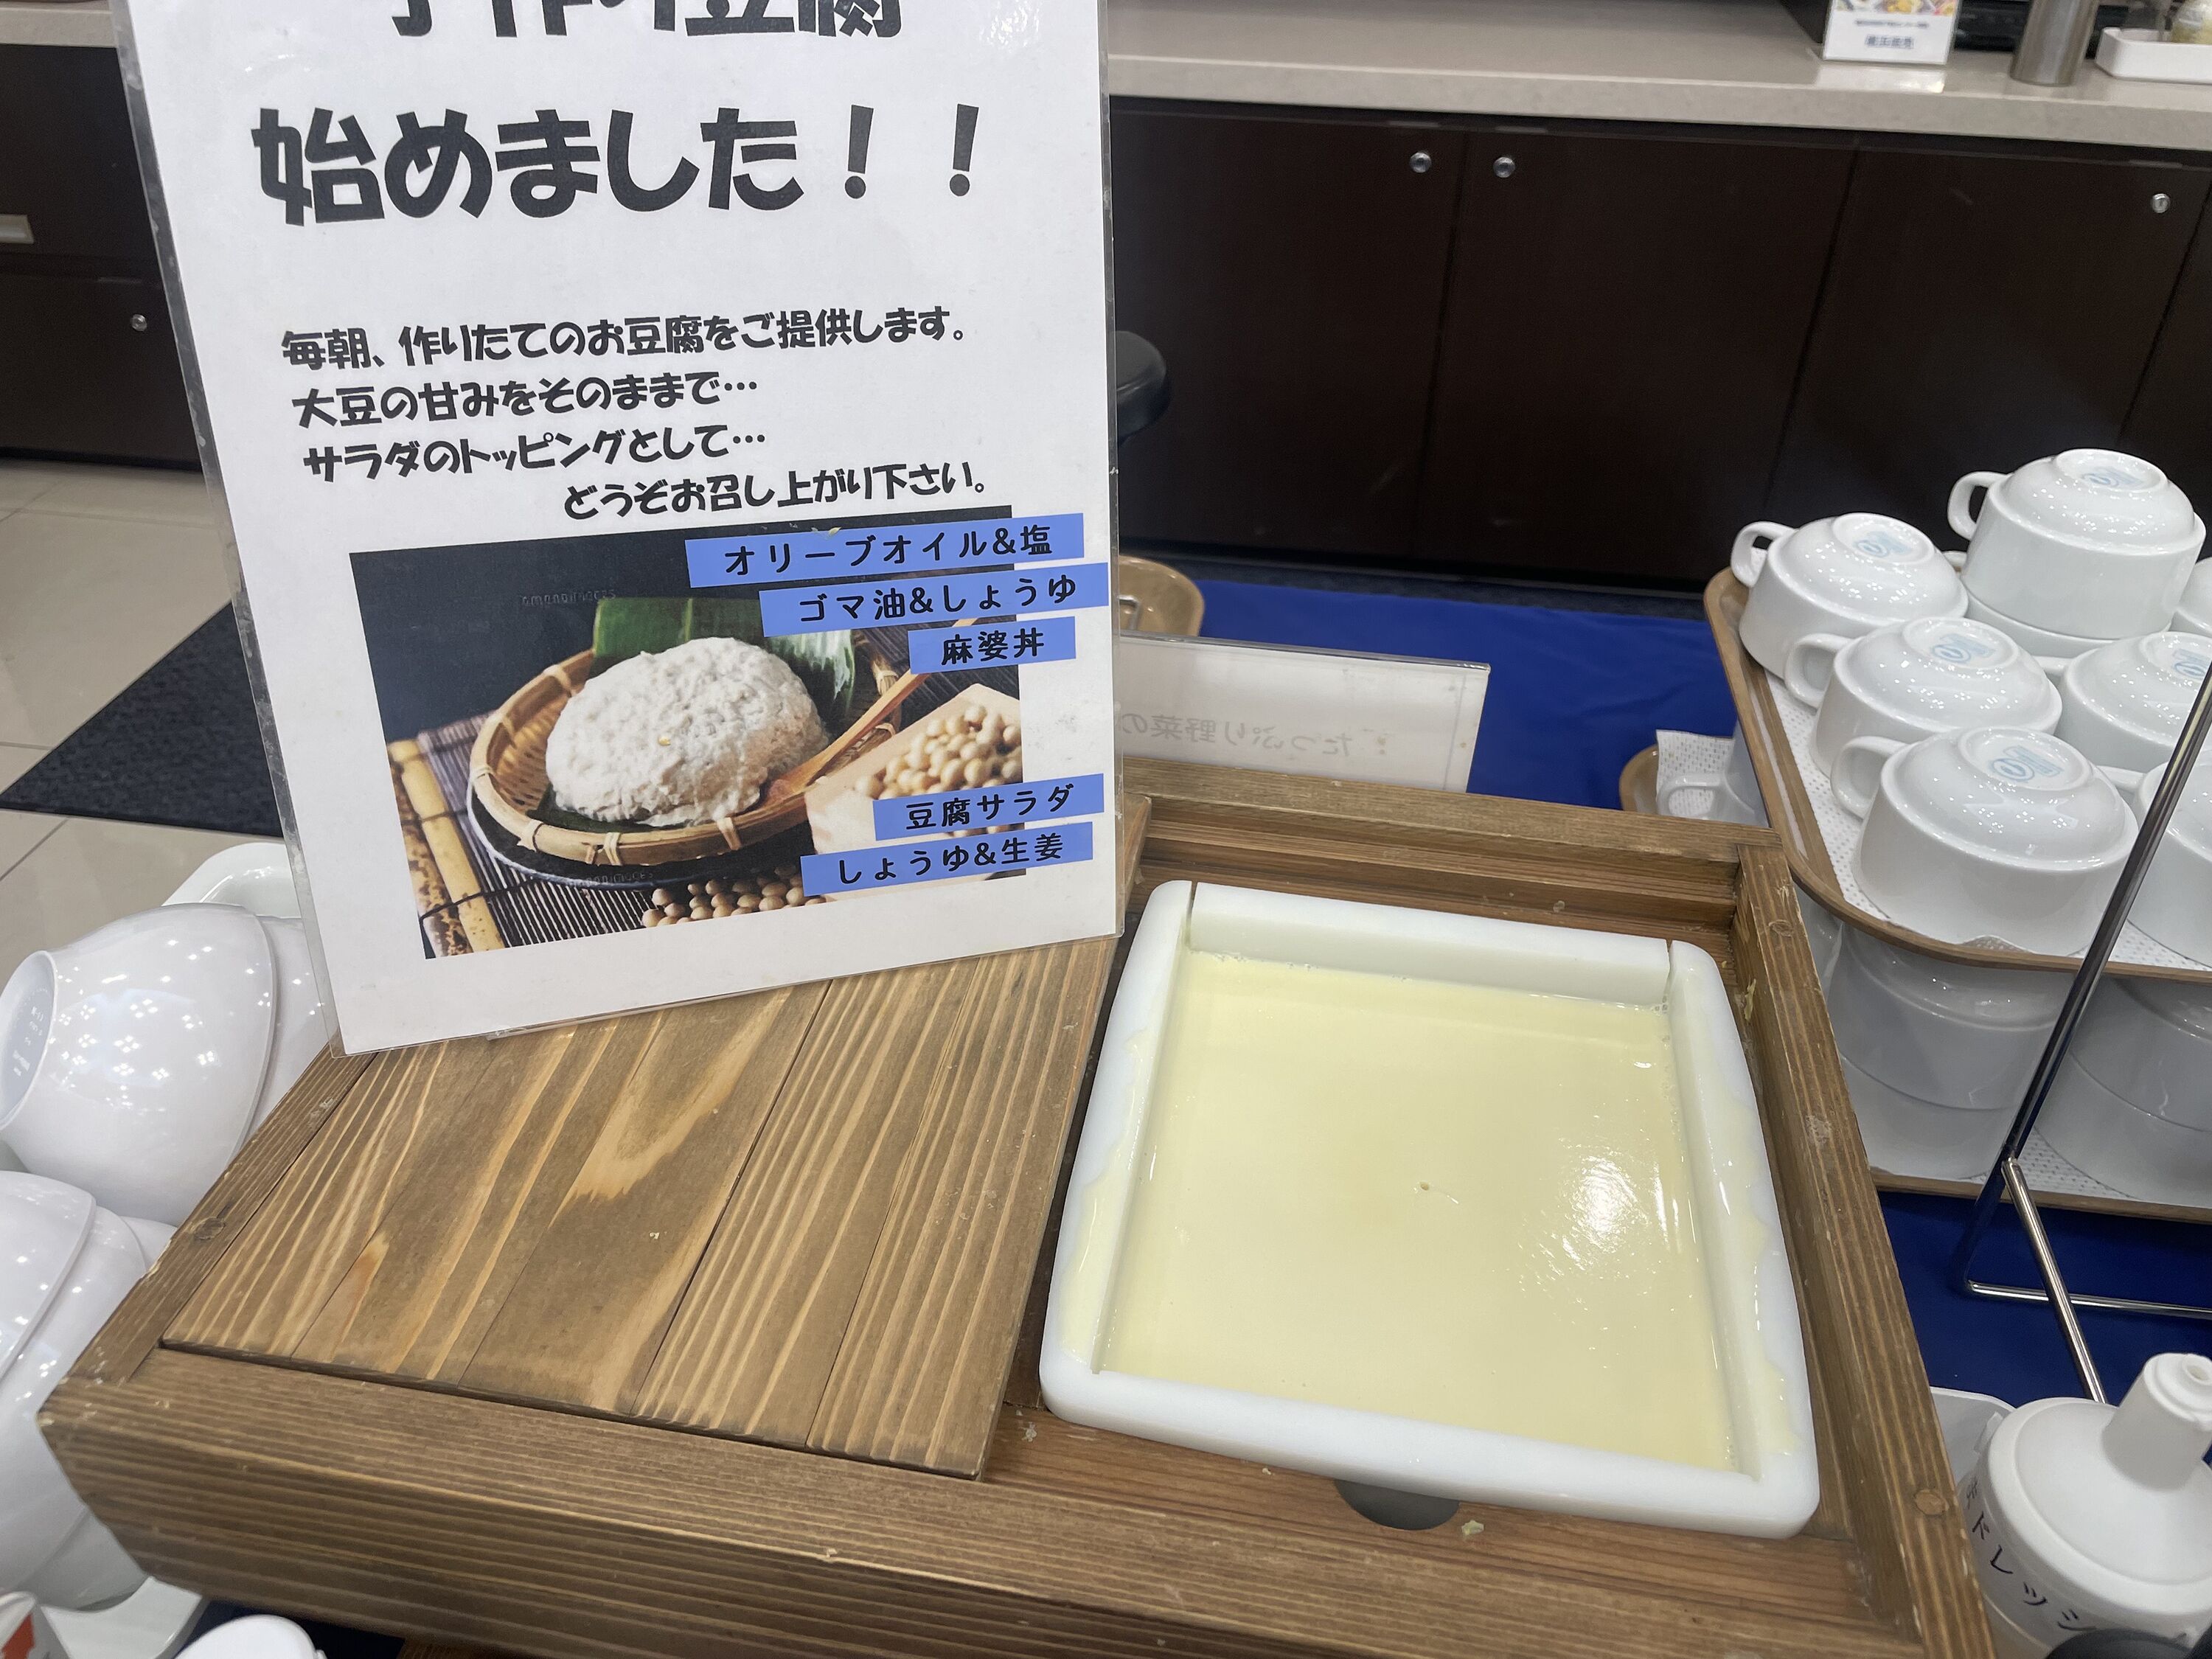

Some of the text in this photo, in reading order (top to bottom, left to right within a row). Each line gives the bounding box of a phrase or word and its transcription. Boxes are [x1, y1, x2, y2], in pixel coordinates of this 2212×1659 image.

[250, 103, 980, 226] 始めました！！
[281, 305, 964, 370] 毎朝、作りたてのお豆腐をご提供します。
[292, 371, 757, 428] 大豆の甘みをそのままで…
[303, 425, 765, 482] サラダのトッピングとして…
[564, 462, 985, 519] どうぞお召し上がり下さい。
[724, 524, 1053, 576] オリーブオイル&塩
[799, 574, 1077, 623] ゴマ油&しょうゆ
[941, 627, 1045, 666] 麻婆丼
[905, 783, 1075, 830] 豆腐サラダ
[838, 832, 1064, 885] しょうゆ&生姜
[1966, 1474, 2098, 1632] ドレッシ
